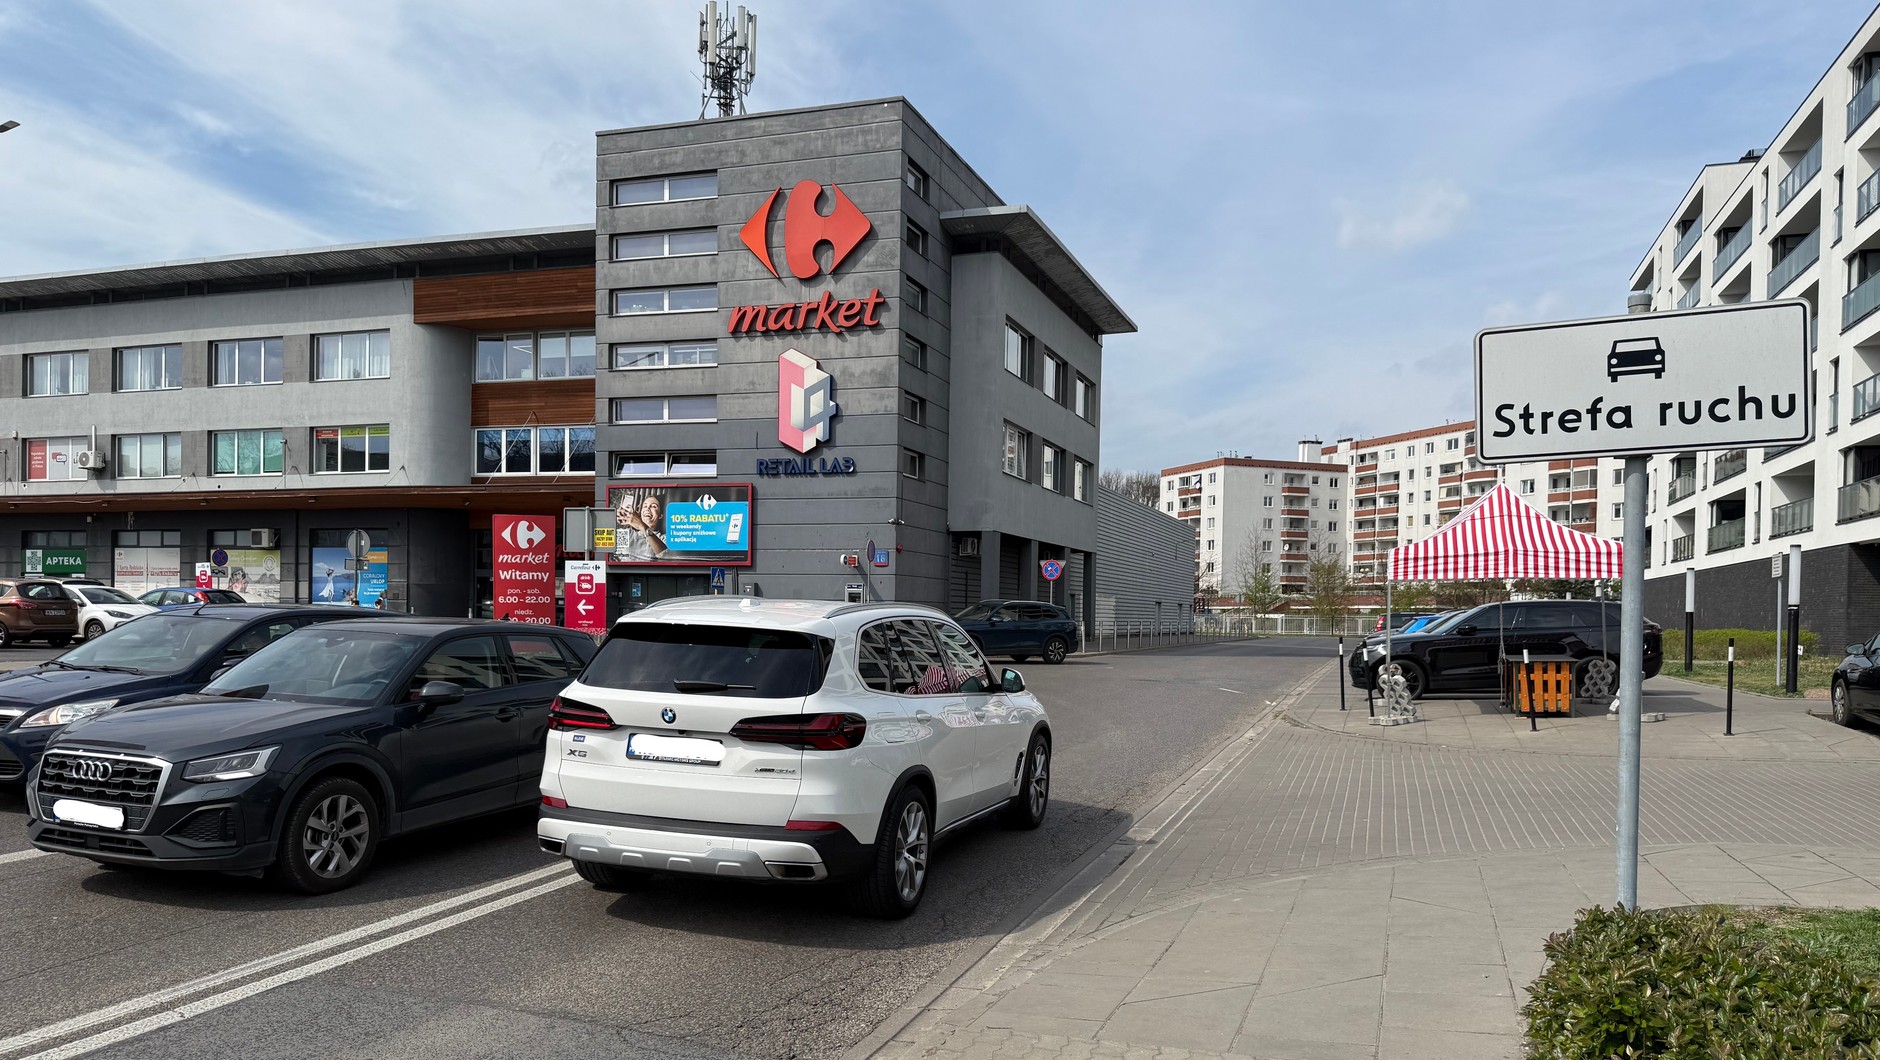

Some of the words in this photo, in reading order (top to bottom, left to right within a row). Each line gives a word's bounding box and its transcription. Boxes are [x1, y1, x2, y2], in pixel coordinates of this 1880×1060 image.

[727, 288, 886, 333] market
[1492, 396, 1633, 438] Strefa
[1659, 385, 1797, 426] ruchu
[756, 457, 817, 475] RETAIL
[819, 456, 855, 474] LAB
[671, 514, 688, 523] 10%
[46, 556, 82, 566] APTEKA
[498, 551, 550, 565] market
[498, 568, 550, 583] Witamy
[498, 596, 519, 604] 6.00
[525, 596, 551, 604] 22.00
